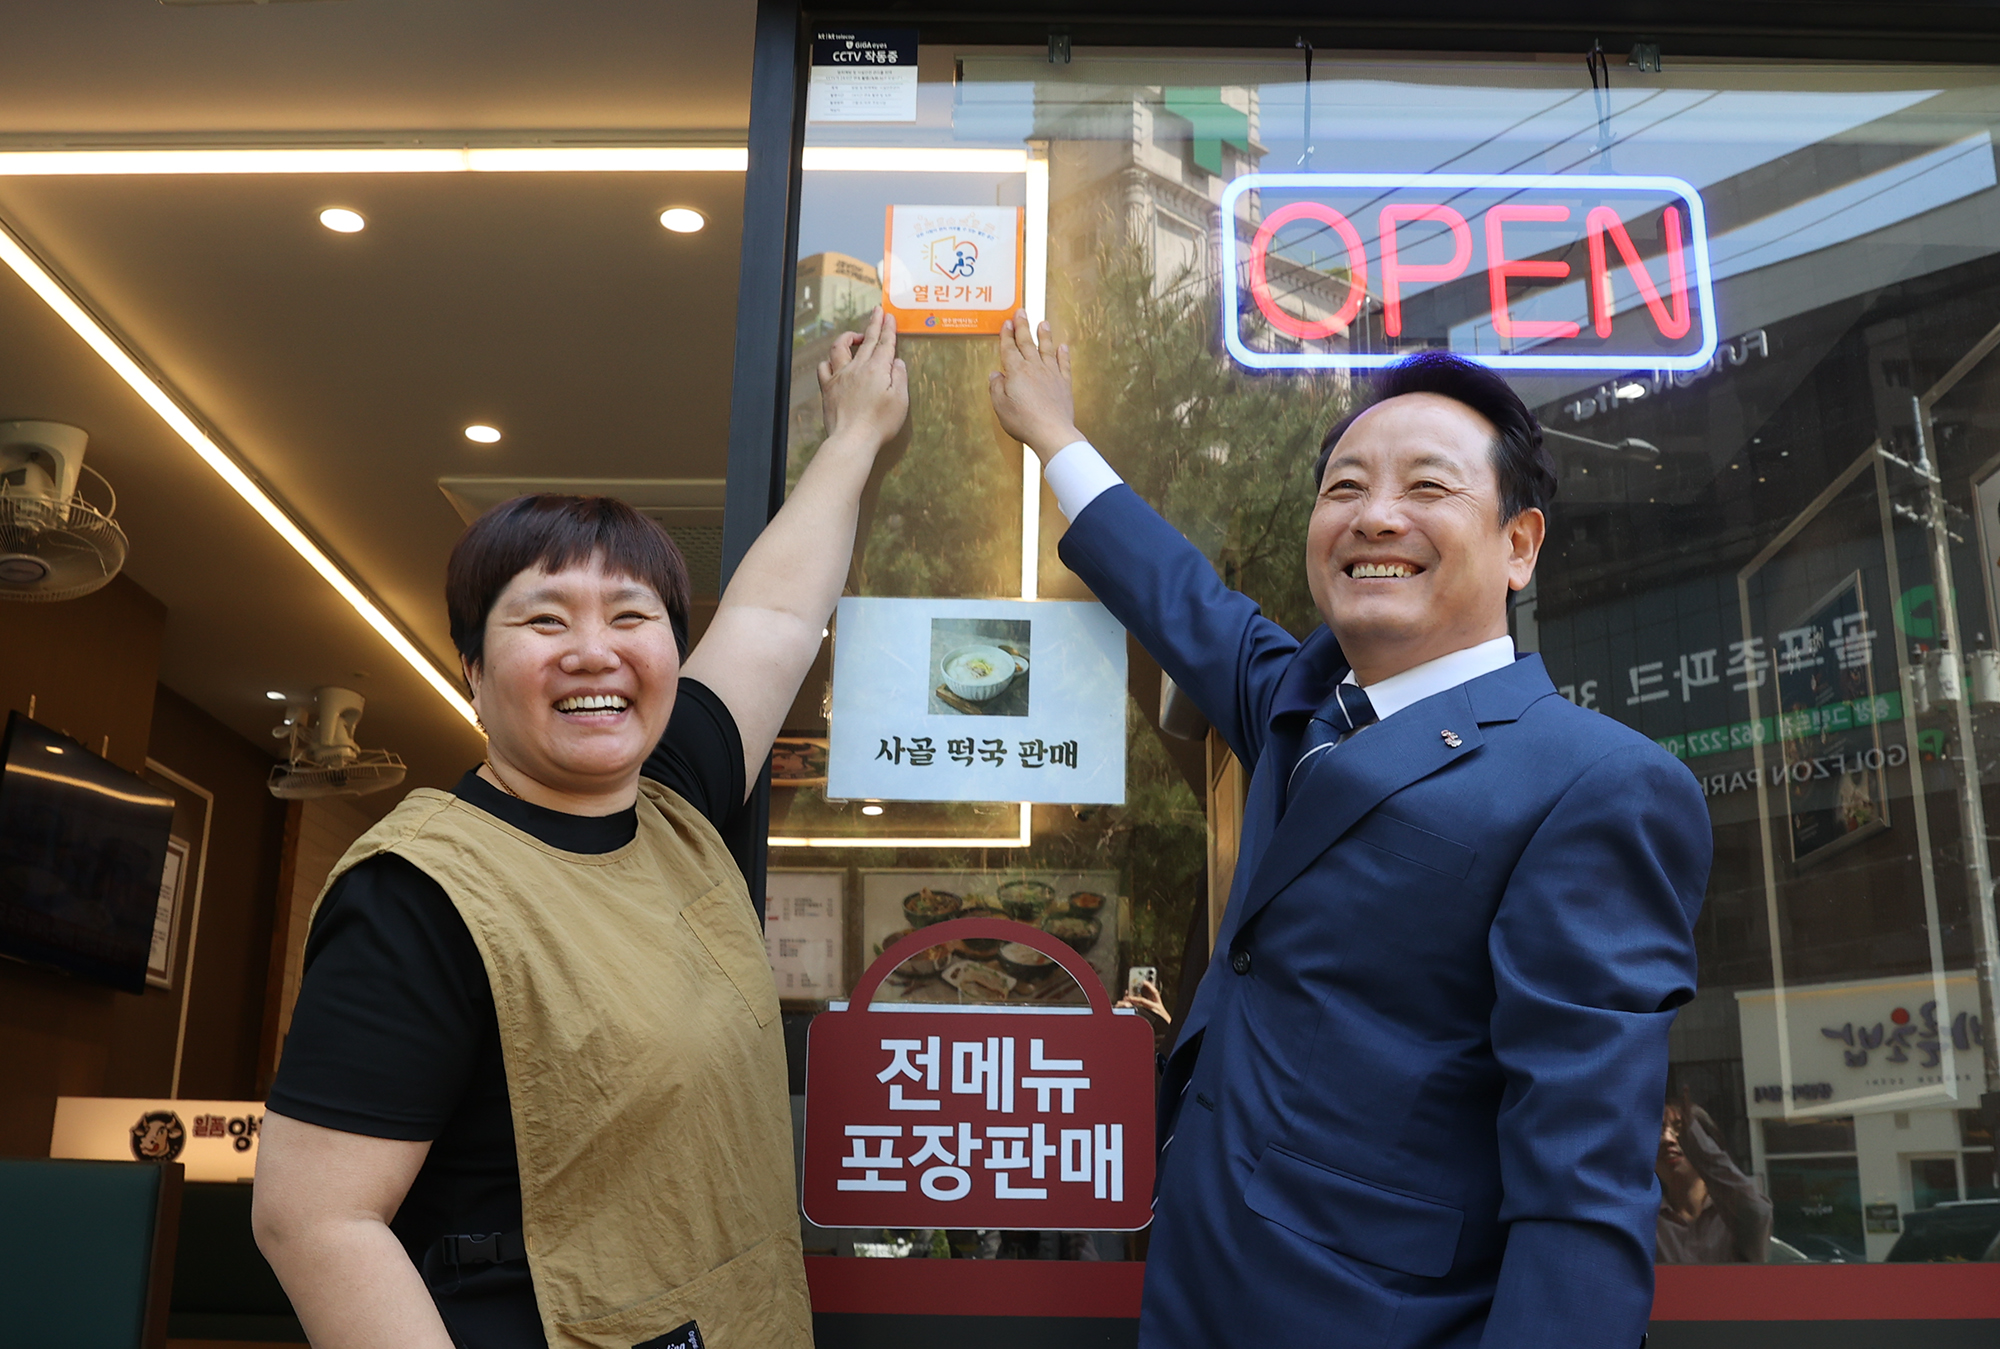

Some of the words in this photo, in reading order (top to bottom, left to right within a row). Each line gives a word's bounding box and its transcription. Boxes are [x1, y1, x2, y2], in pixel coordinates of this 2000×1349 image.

[832, 51, 861, 62] CCTV
[864, 50, 898, 64] 작동중
[1249, 201, 1692, 340] OPEN
[912, 284, 993, 303] 열린가게
[874, 735, 936, 766] 사골
[947, 737, 1007, 768] 떡국
[1018, 738, 1079, 769] 판매
[875, 1036, 1091, 1114] 전메뉴
[192, 1113, 226, 1138] 일품
[836, 1122, 1124, 1202] 포장판매
